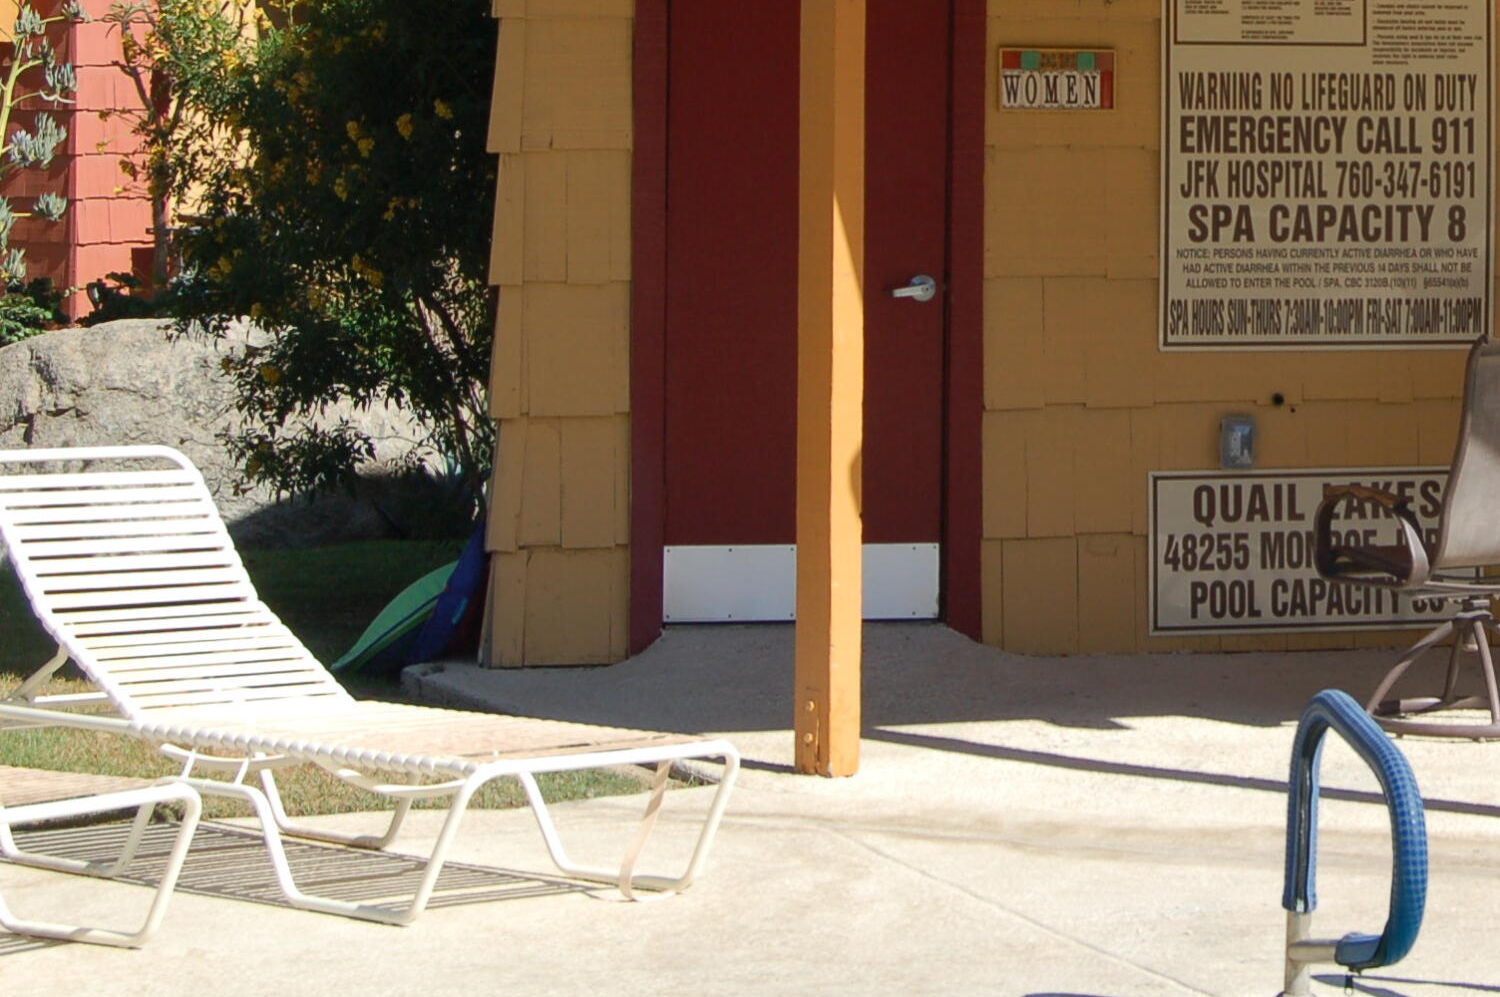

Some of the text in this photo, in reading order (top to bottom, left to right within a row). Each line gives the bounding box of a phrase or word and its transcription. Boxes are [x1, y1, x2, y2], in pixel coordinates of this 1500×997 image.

[1003, 74, 1097, 104] WOMEN
[1179, 72, 1477, 112] WARNING NO LIFEGUARD ON DUTY
[1180, 116, 1475, 154] EMERGENCY CALL 911
[1180, 160, 1476, 199] JFK HOSPITAL 760-347-6191
[1188, 204, 1467, 243] SPA CAPACITY 8
[1176, 248, 1479, 259] NOTICE: PERSONS HAVING CURRENTLY ACTIVE DIARRHEA OR WHO HAVE
[1183, 263, 1472, 273] HAD ACTIVE DIARRHEA WITHIN THE PREVIOUS 14 DAYS SHALL NOT BE
[1186, 278, 1228, 288] ALLOWED
[1230, 278, 1242, 288] TO
[1244, 278, 1272, 288] ENTER
[1274, 278, 1291, 288] THE
[1293, 278, 1316, 288] POOL
[1345, 278, 1362, 288] CBC
[1170, 299, 1189, 335] SPA
[1192, 299, 1225, 335] HOURS
[1227, 299, 1282, 335] SUN-THURS
[1366, 299, 1402, 334] FRI-SAT
[1193, 483, 1305, 527] QUAIL
[1164, 532, 1250, 572] 48255
[1260, 530, 1377, 570] MON
[1190, 578, 1399, 620] POOL CAPACITY
